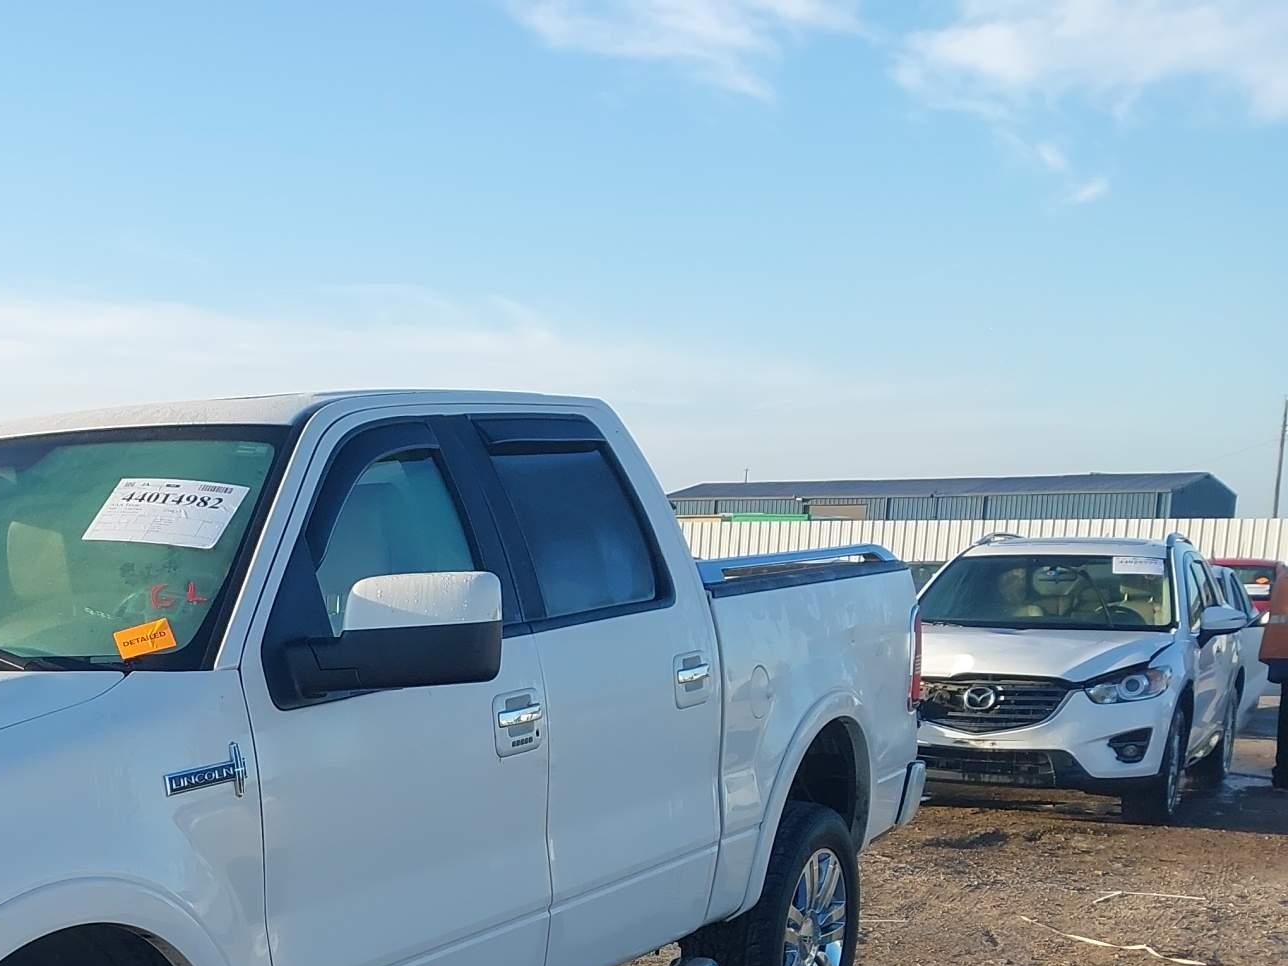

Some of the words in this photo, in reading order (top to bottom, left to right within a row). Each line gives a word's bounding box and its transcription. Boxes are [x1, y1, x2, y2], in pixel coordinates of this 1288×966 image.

[122, 491, 224, 510] 44014982
[122, 631, 166, 647] DETAILED
[172, 766, 234, 789] LINCOLN
